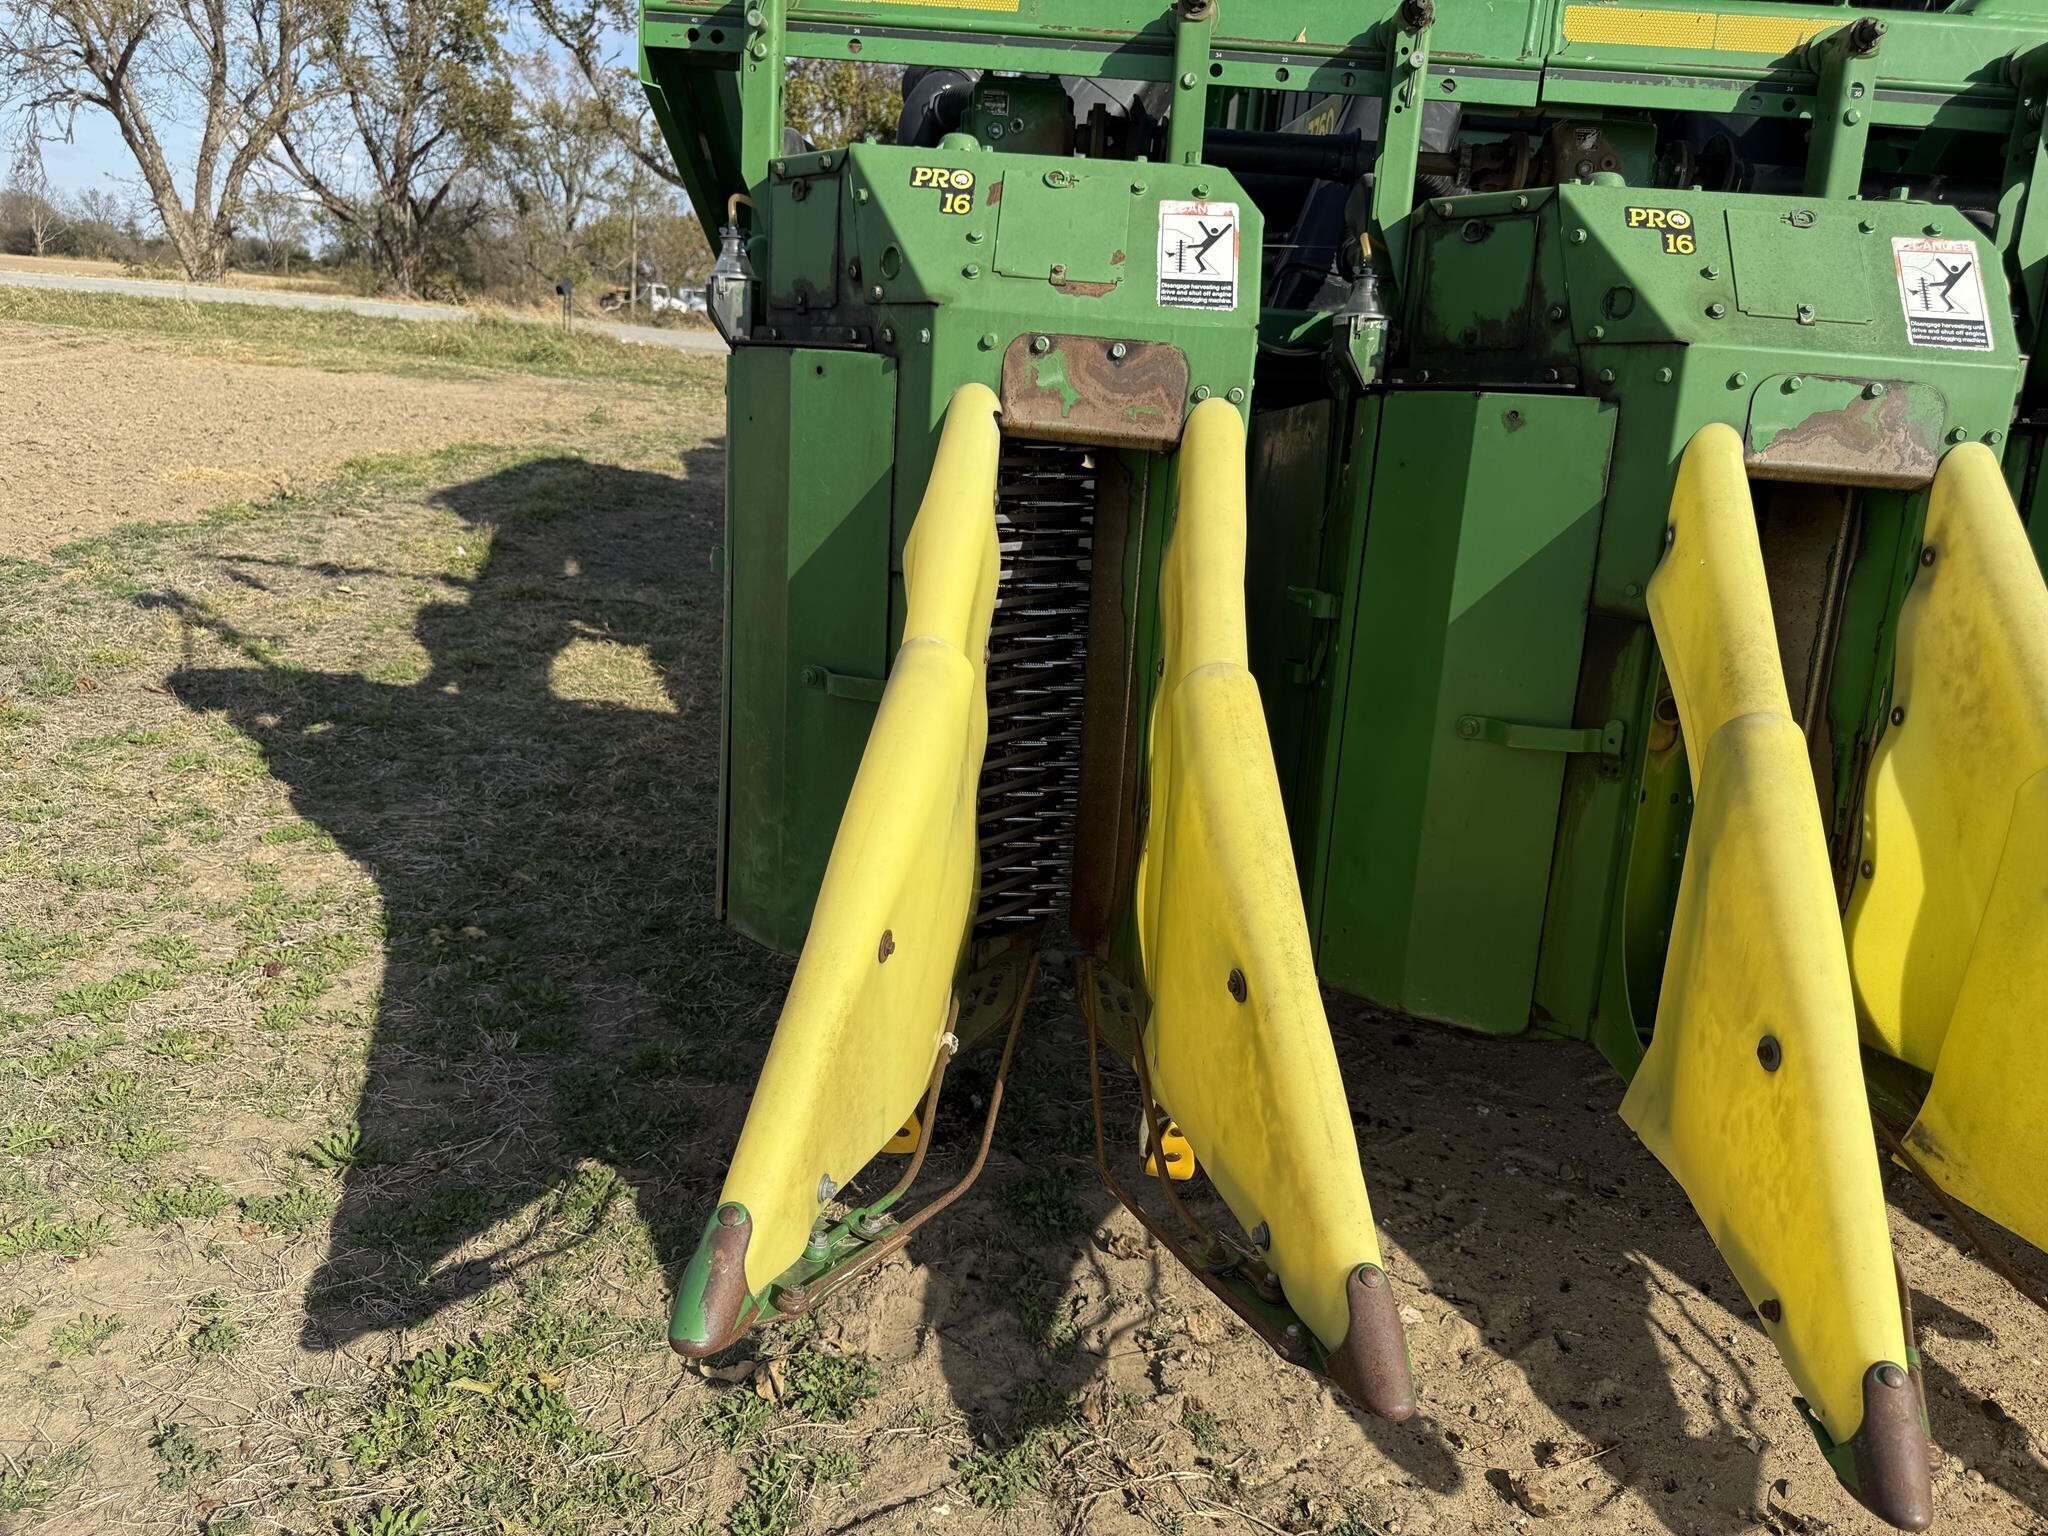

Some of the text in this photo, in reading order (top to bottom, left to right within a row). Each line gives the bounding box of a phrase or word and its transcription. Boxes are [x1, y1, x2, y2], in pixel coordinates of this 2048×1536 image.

[912, 167, 974, 190] PRO
[942, 193, 971, 214] 16
[1628, 208, 1691, 230] PRO
[1665, 234, 1694, 254] 16
[1161, 282, 1190, 290] Disengage
[1190, 283, 1220, 291] harvesting
[1910, 320, 1940, 328] Disengage
[1941, 322, 1972, 330] harvesting
